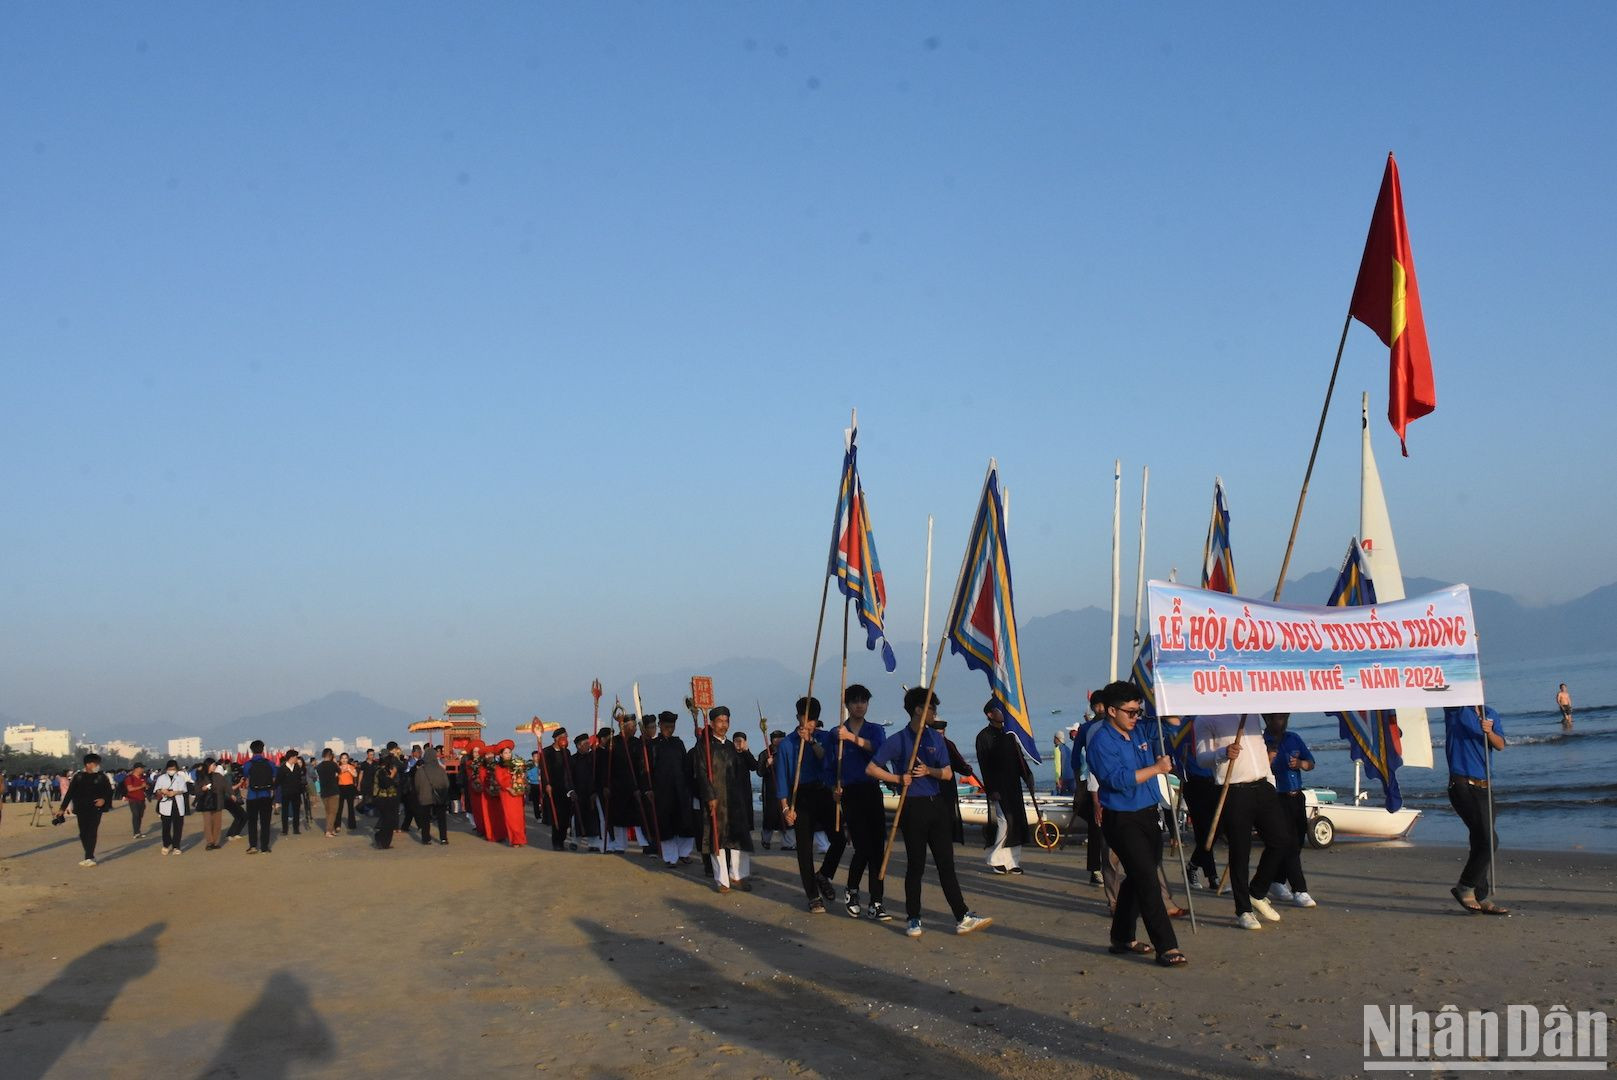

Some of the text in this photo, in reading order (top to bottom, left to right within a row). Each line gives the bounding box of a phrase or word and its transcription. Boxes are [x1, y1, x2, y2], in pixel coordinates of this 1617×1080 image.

[1158, 597, 1467, 660] LỄ HỘI CẦU NGƯ TRUYỀN THỐNG
[1193, 665, 1243, 697] QUẬN
[1247, 669, 1306, 692] THANH
[1309, 666, 1345, 691] KHÊ
[1359, 664, 1400, 689] NĂM
[1404, 667, 1444, 689] 2024
